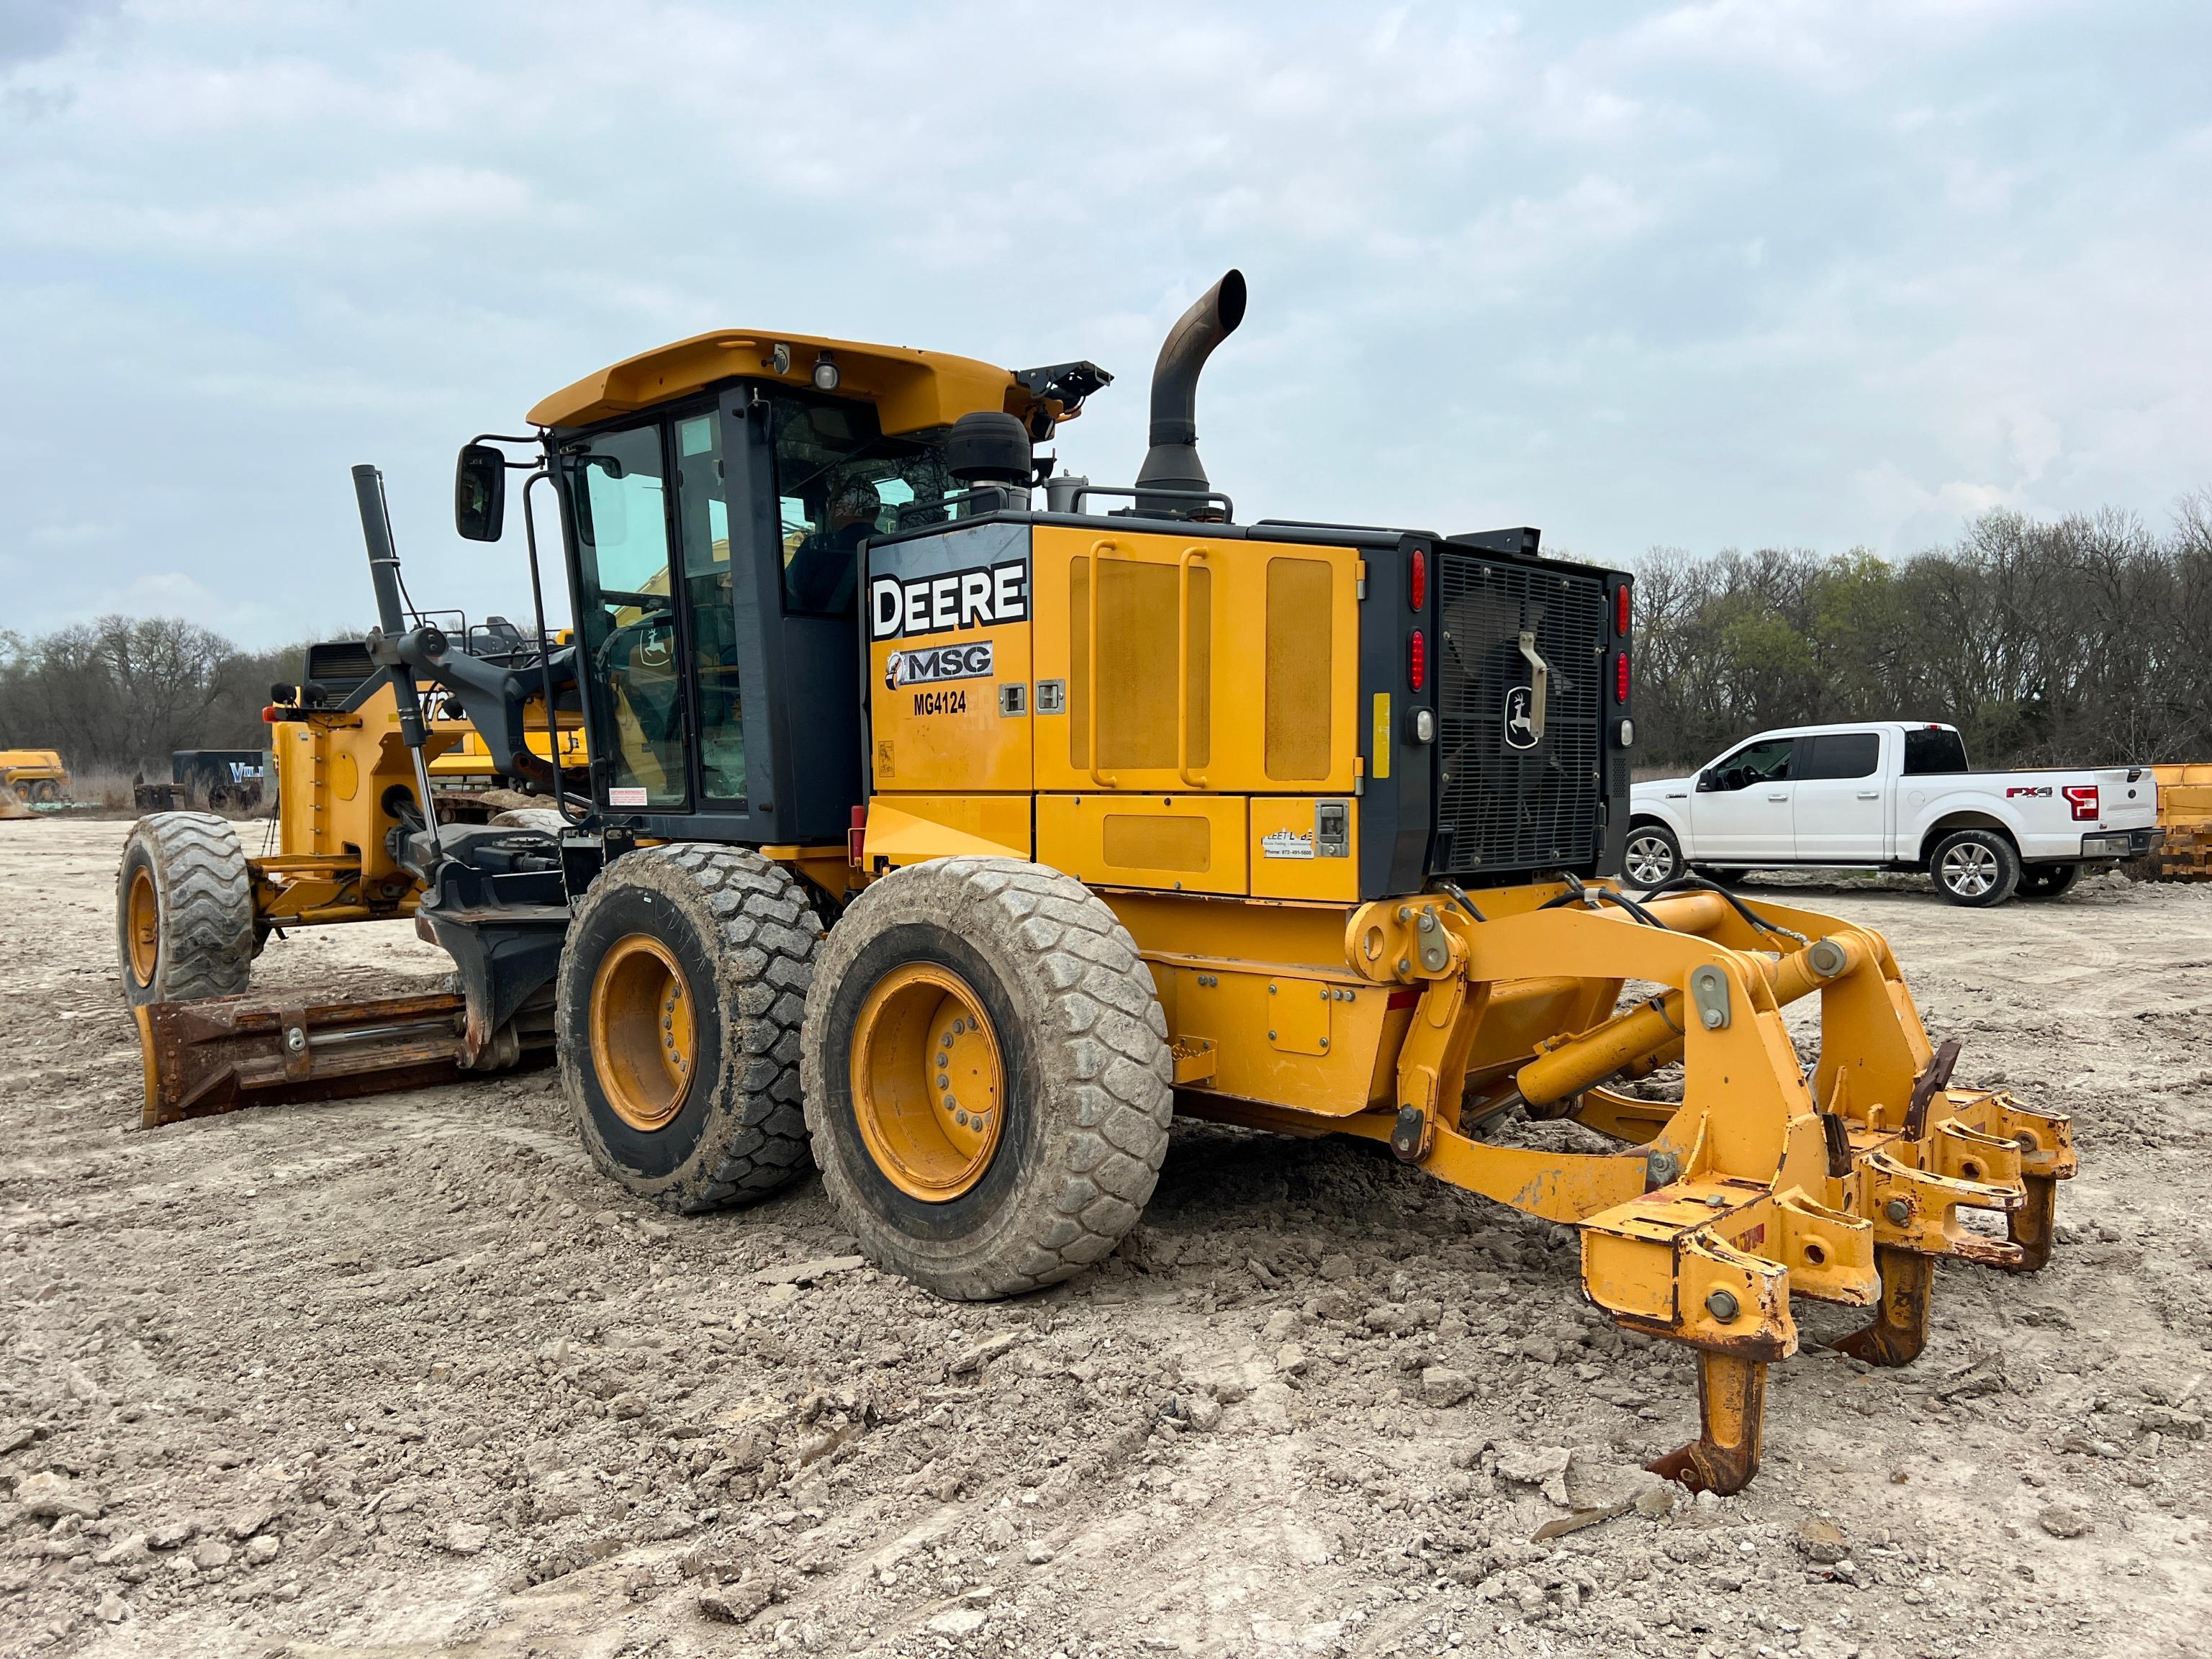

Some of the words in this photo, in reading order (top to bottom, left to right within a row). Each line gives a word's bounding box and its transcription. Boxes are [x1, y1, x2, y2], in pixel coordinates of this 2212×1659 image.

[872, 564, 1025, 638] DEERE
[908, 646, 992, 680] MSG
[913, 690, 967, 716] MG4124
[2005, 787, 2053, 798] FX4
